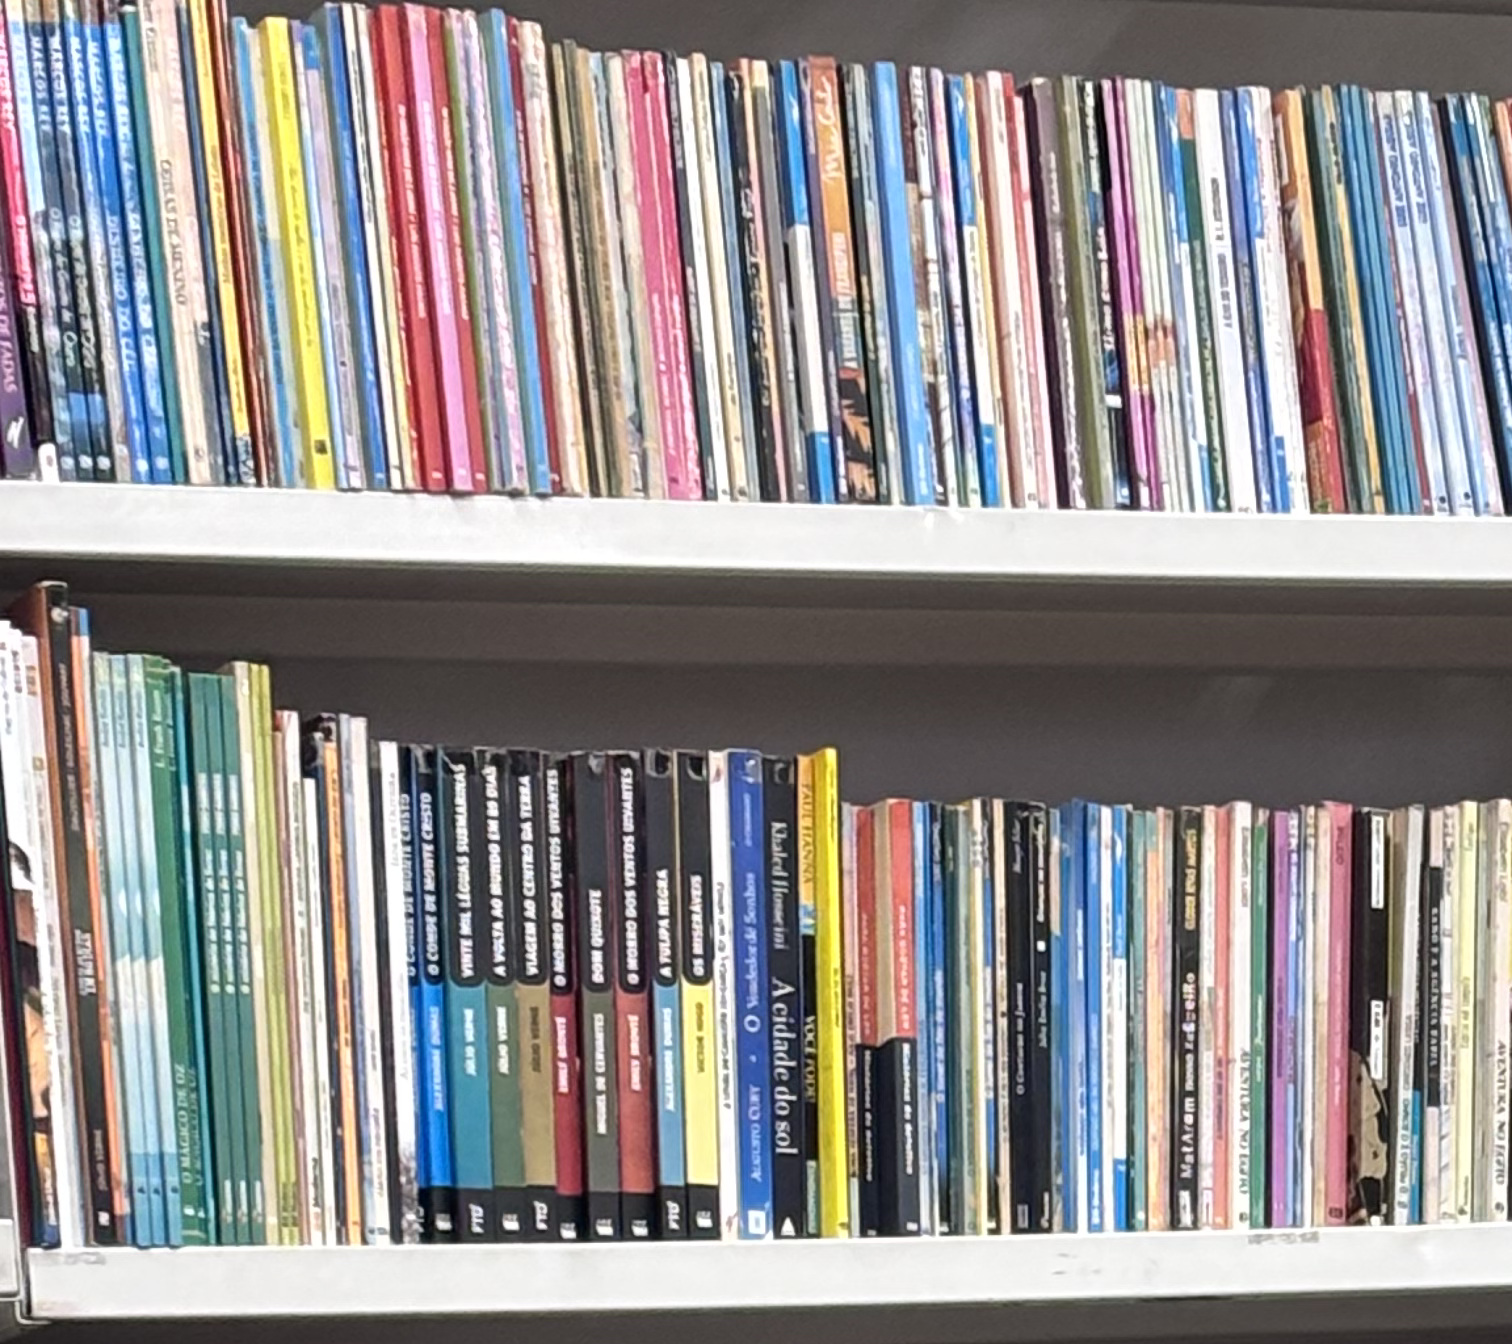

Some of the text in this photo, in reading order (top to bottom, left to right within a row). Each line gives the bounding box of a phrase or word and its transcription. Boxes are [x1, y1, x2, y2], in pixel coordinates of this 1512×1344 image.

[482, 765, 498, 798] DIAS
[486, 819, 500, 840] EM
[801, 783, 814, 884] PAUL HANNA
[420, 792, 440, 976] O CONDE DE MONTE CRISTO
[452, 764, 474, 977] VINTE MIL LÉGUAS SUBMARINAS
[488, 843, 502, 896] MUNDO
[518, 775, 539, 976] VIAGEM AO CENTRO DA TERRA
[623, 835, 636, 887] VENTOS
[770, 821, 790, 950] Khaled Hosseini
[490, 898, 503, 918] AO
[549, 837, 566, 987] O MORRO DOS VENTOS
[624, 890, 637, 918] DOS
[656, 868, 673, 978] A TULIPA NEGRA
[688, 874, 705, 976] OS MISERÁVEIS
[743, 873, 757, 924] Sonhos
[492, 921, 505, 962] VOLTA
[588, 889, 604, 984] DOM QUIXOTE
[626, 922, 638, 971] MORRO
[493, 965, 506, 977] A
[627, 974, 639, 985] O
[743, 947, 758, 1009] Vendedor
[743, 1015, 761, 1033] O
[772, 976, 799, 1155] A cidade do sol
[749, 1084, 762, 1182] AUGUSTO CURY
[902, 1042, 914, 1175] Histórias de detetive
